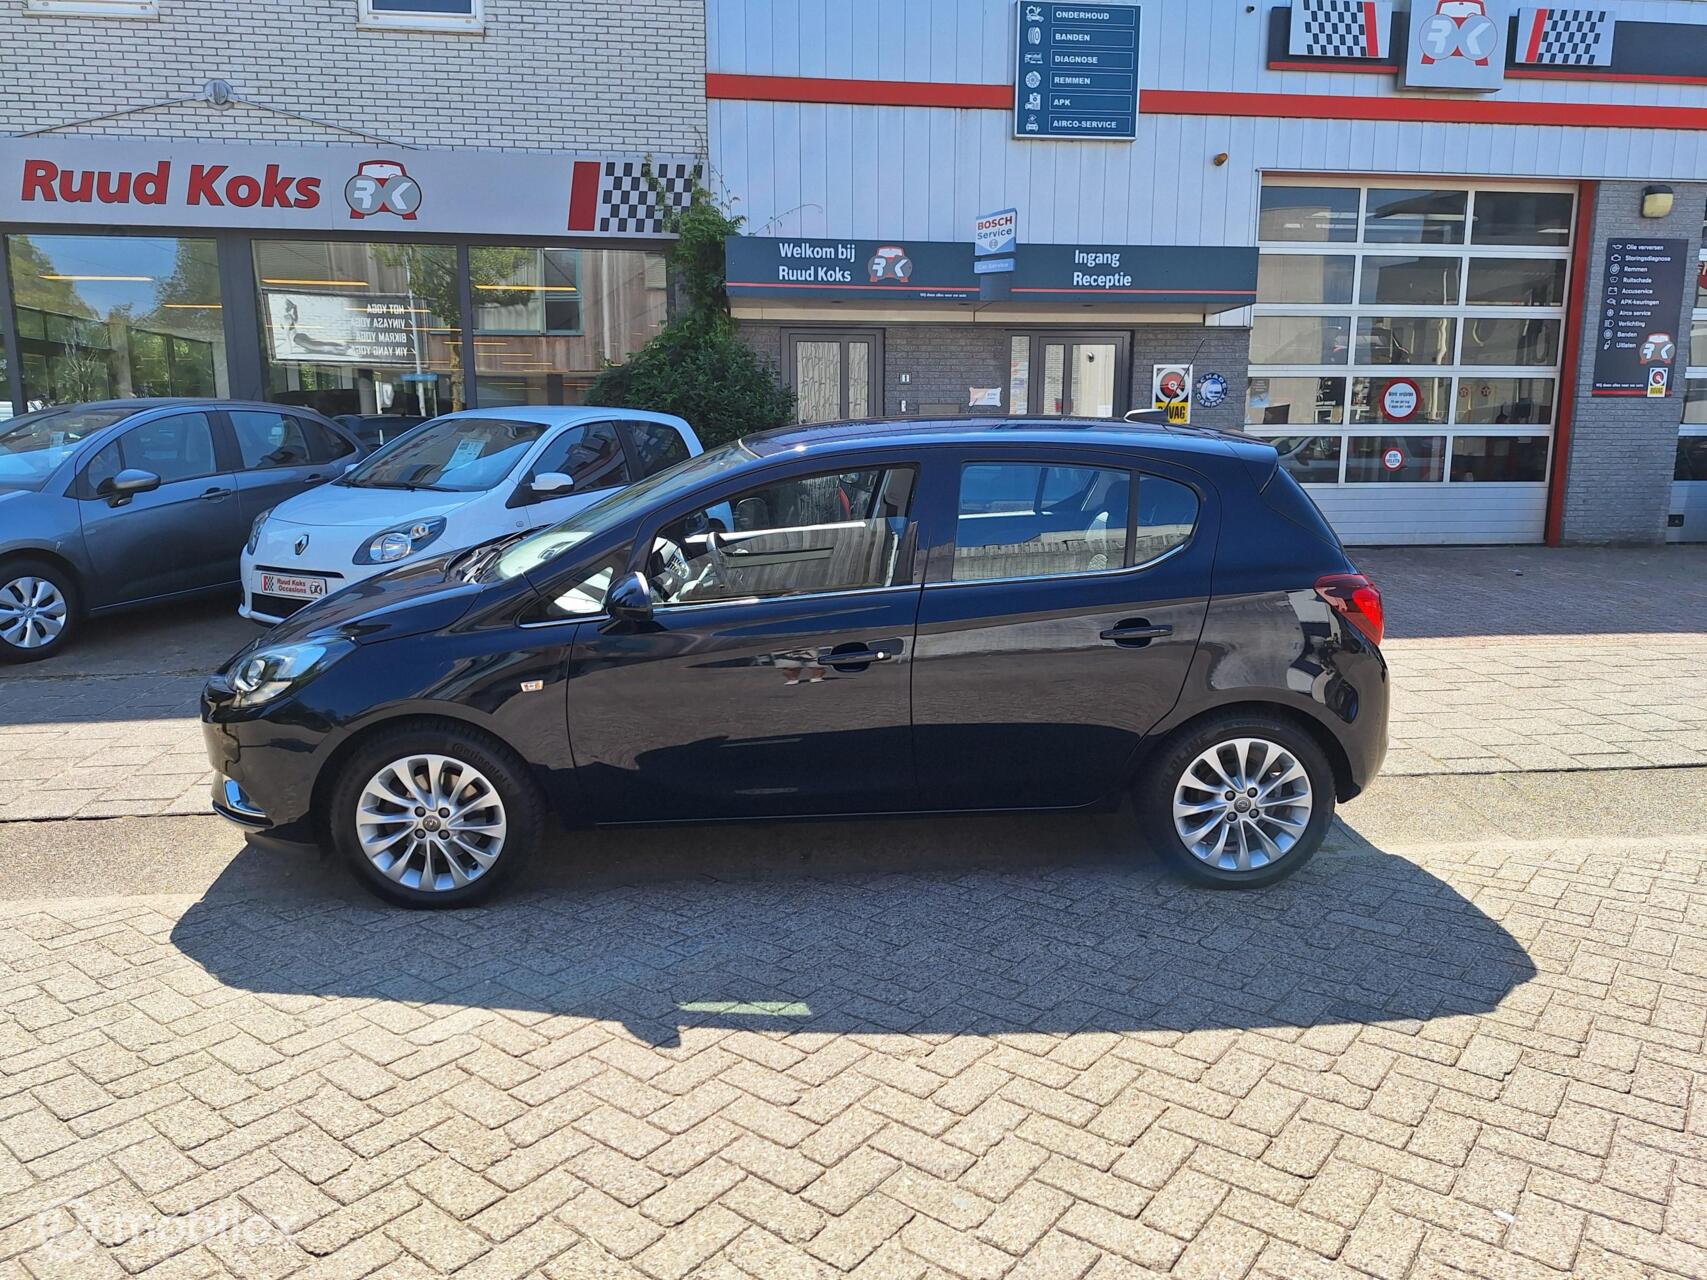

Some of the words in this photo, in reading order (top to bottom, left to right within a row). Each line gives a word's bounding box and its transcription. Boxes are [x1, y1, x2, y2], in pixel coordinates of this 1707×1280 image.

[1056, 11, 1109, 20] ONDERHOUD
[1053, 120, 1117, 128] AIRCO-SERVICE
[21, 159, 170, 205] Ruud
[187, 164, 321, 209] Koks
[977, 216, 1013, 230] BOSCH
[977, 228, 1013, 240] Service
[778, 242, 835, 260] Welkom
[838, 243, 855, 263] bij
[1074, 250, 1120, 268] Ingang
[778, 266, 815, 281] Ruud
[817, 267, 851, 282] Koks
[1073, 272, 1132, 289] Receptie
[279, 585, 307, 593] Occasions
[451, 743, 508, 783] Continental
